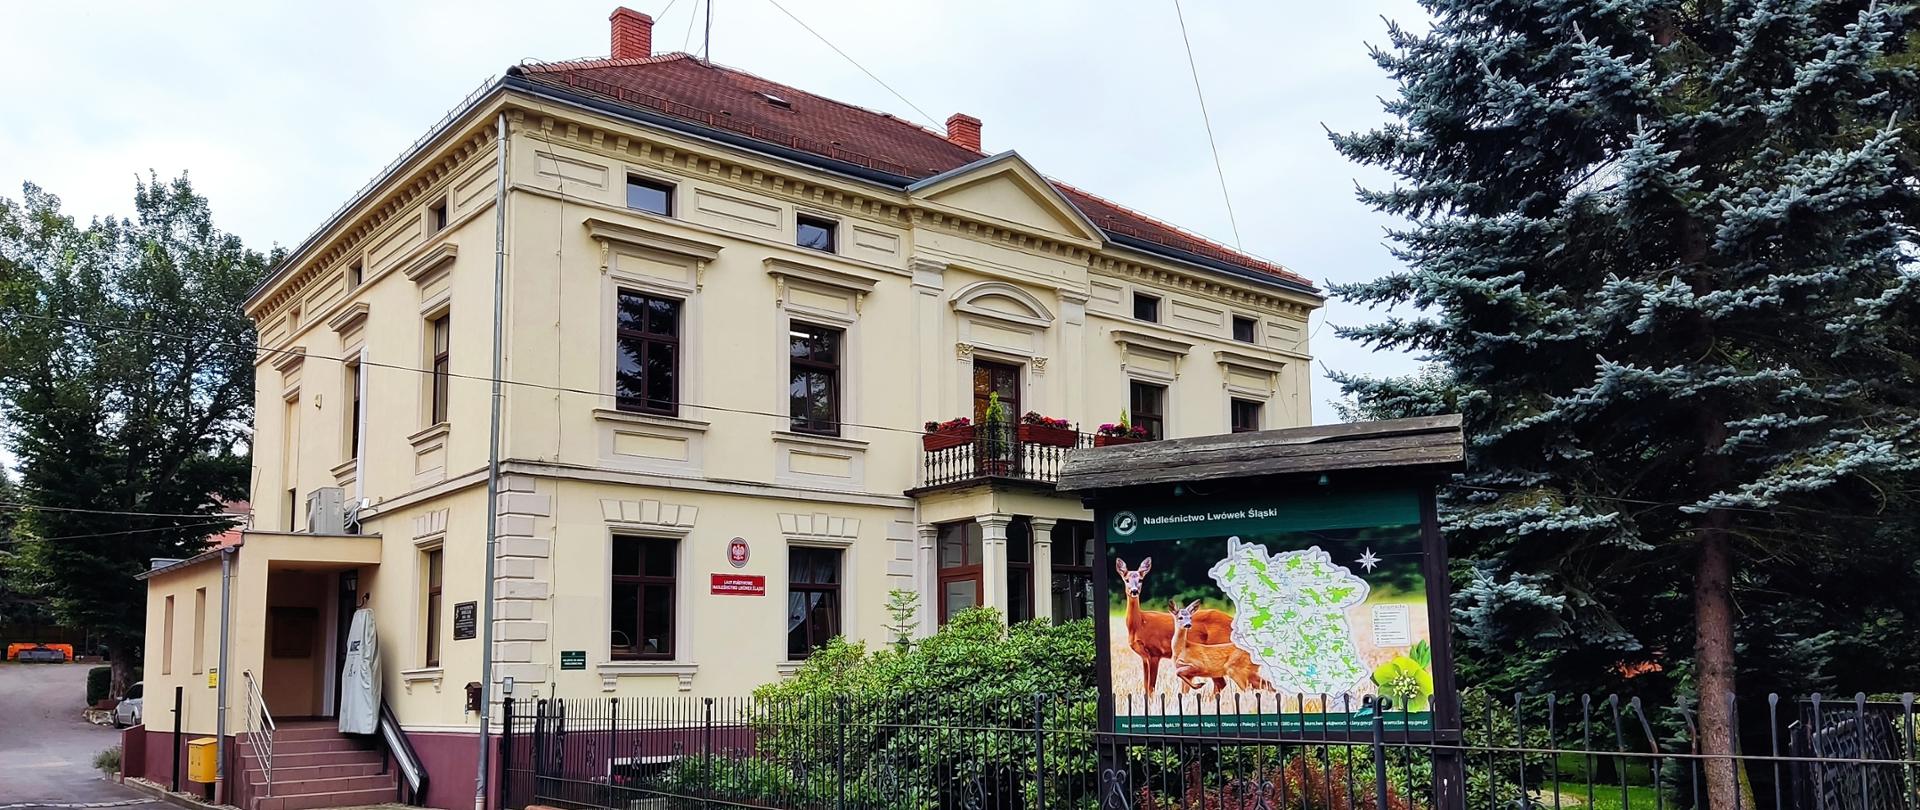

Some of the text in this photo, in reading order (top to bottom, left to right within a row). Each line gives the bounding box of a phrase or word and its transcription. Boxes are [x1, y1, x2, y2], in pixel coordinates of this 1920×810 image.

[1143, 512, 1205, 525] Nadleśnictwo
[1207, 510, 1246, 521] Lwówek
[1248, 507, 1278, 520] Śląski
